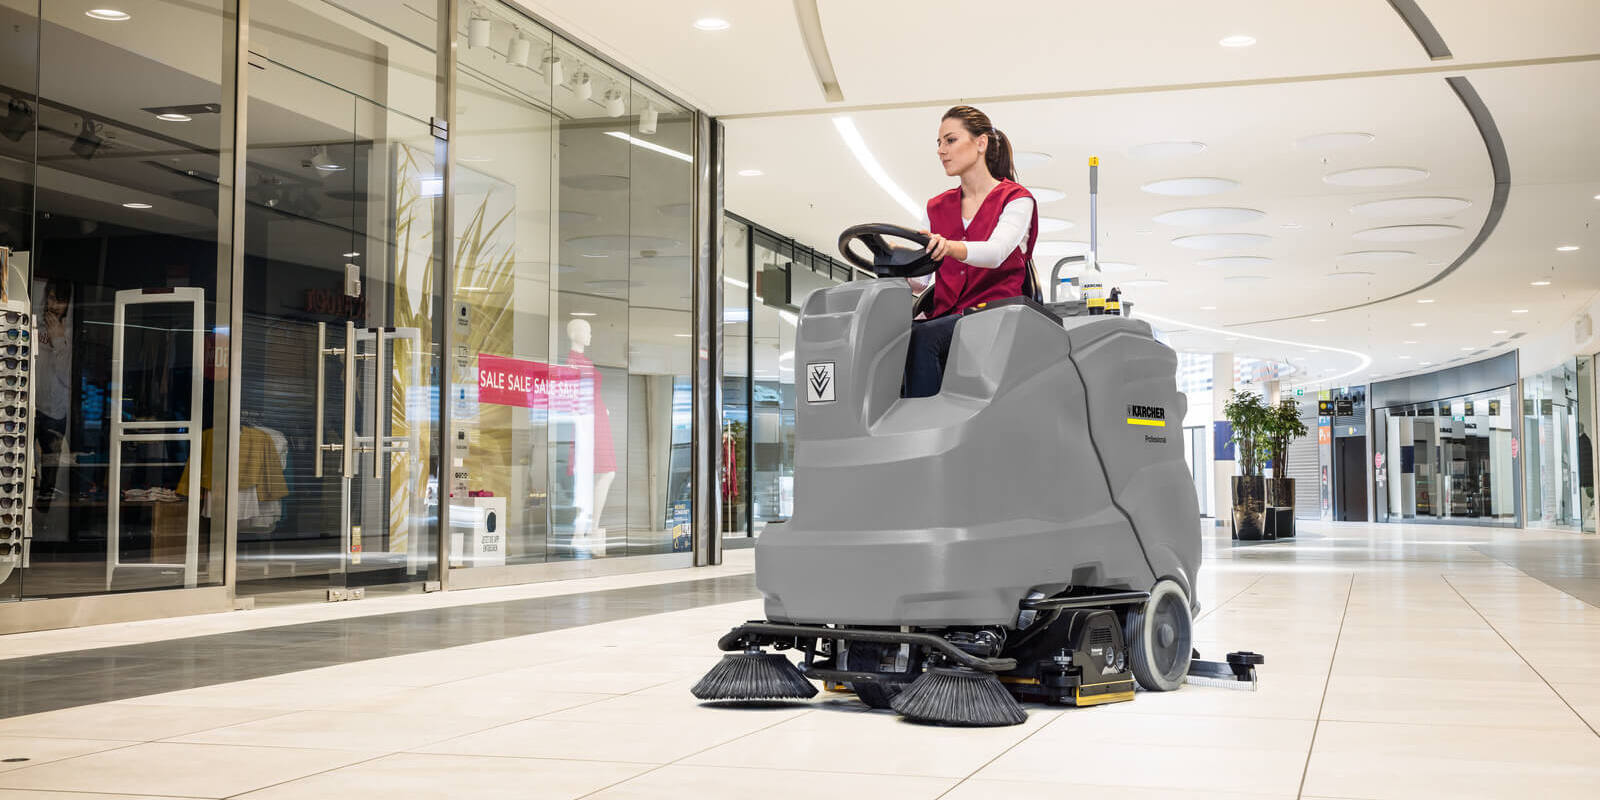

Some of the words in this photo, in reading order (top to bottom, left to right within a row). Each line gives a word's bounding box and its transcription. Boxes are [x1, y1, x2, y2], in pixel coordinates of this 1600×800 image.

[480, 370, 504, 389] SALE
[508, 374, 531, 393] SALE
[534, 378, 555, 396] SALE
[559, 381, 579, 400] SALE
